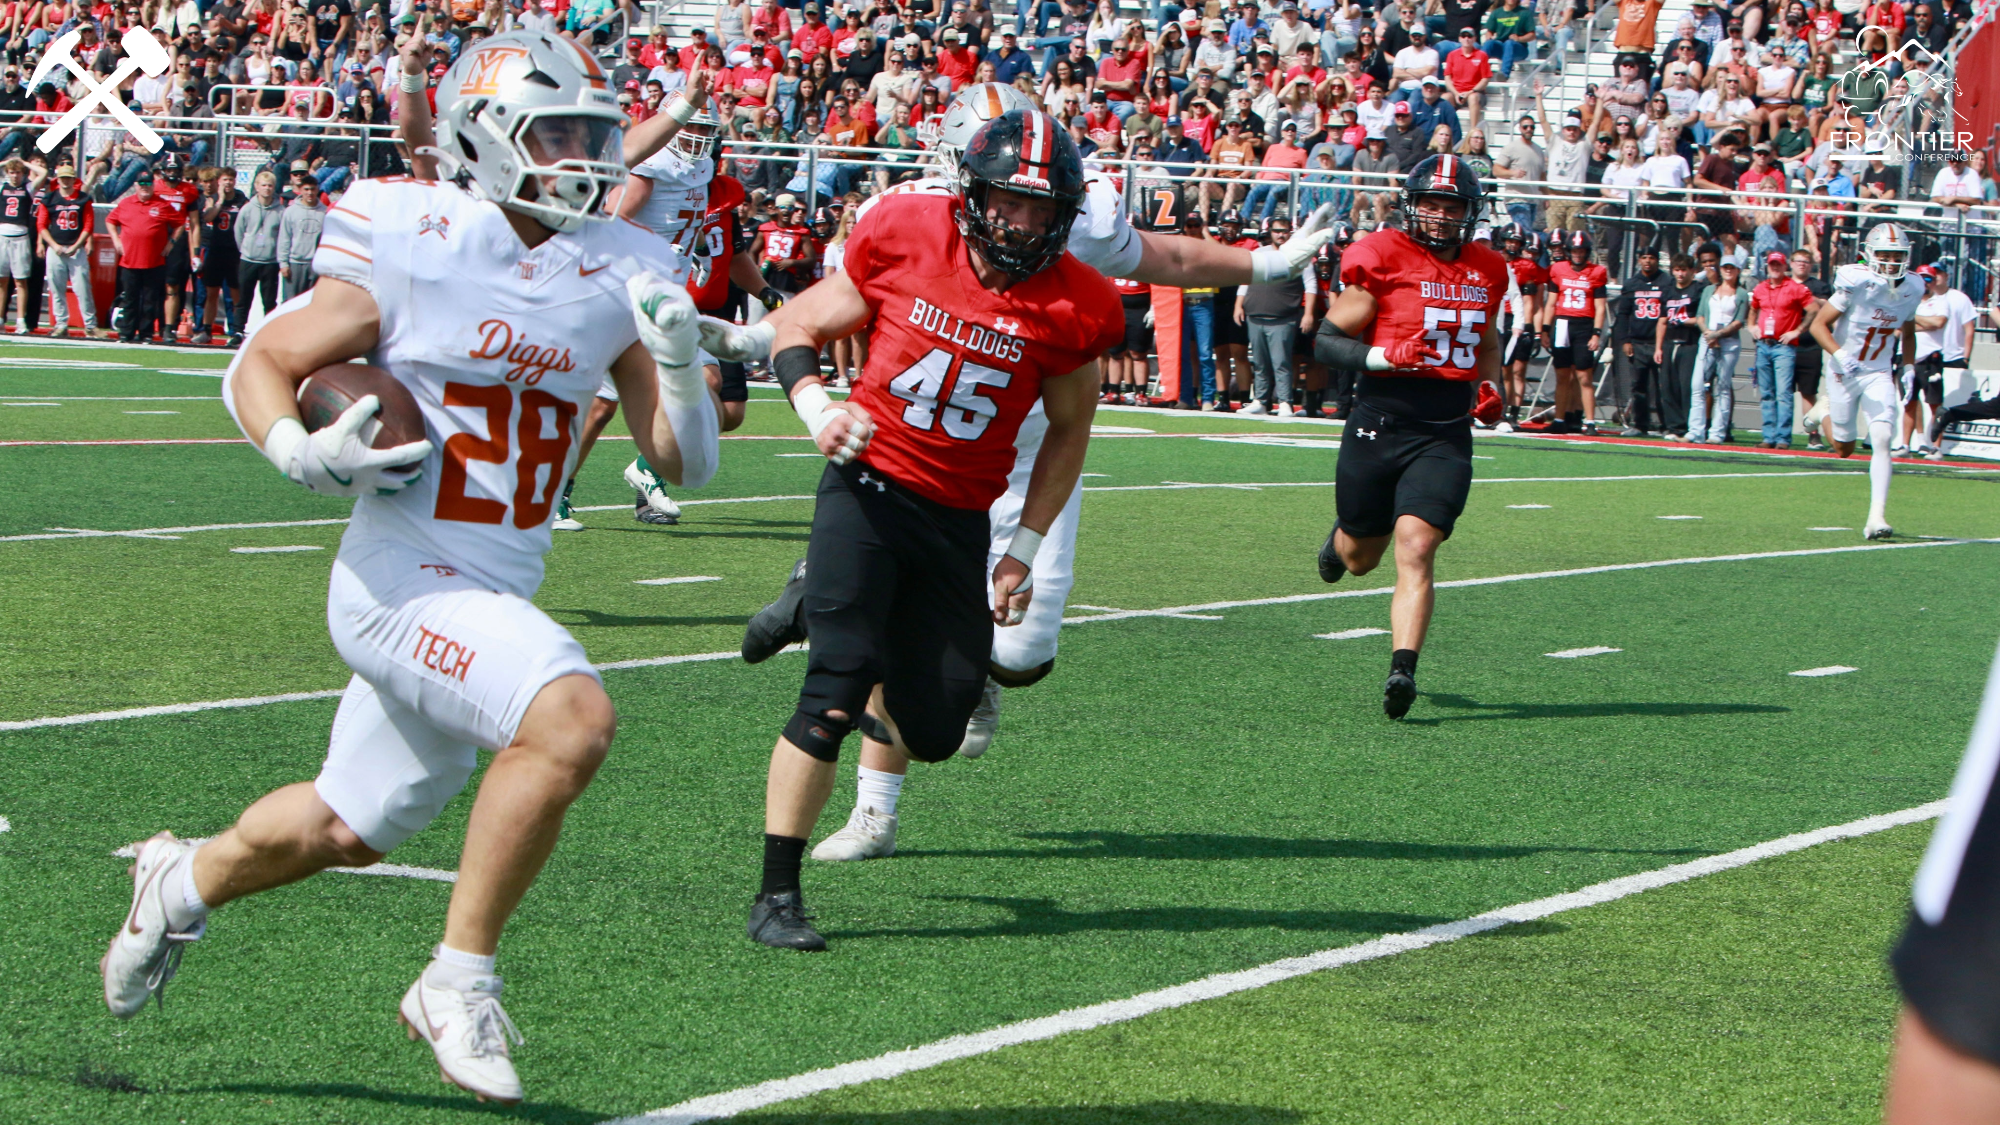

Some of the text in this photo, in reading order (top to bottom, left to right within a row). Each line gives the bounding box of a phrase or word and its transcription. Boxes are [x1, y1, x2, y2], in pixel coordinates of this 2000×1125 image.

[1015, 177, 1047, 189] Riddell
[5, 196, 19, 217] 2
[57, 210, 79, 230] 49
[1153, 191, 1176, 226] 2
[768, 235, 794, 258] 53
[1420, 280, 1488, 304] BULLDOGS
[1562, 288, 1586, 309] 13
[1634, 298, 1661, 319] 33
[908, 296, 1025, 363] BULLDOGS
[1423, 305, 1486, 369] 55
[1858, 327, 1894, 361] 17
[469, 319, 576, 386] Diggs
[889, 346, 1012, 441] 45
[433, 381, 579, 530] 28
[413, 624, 476, 683] TECH
